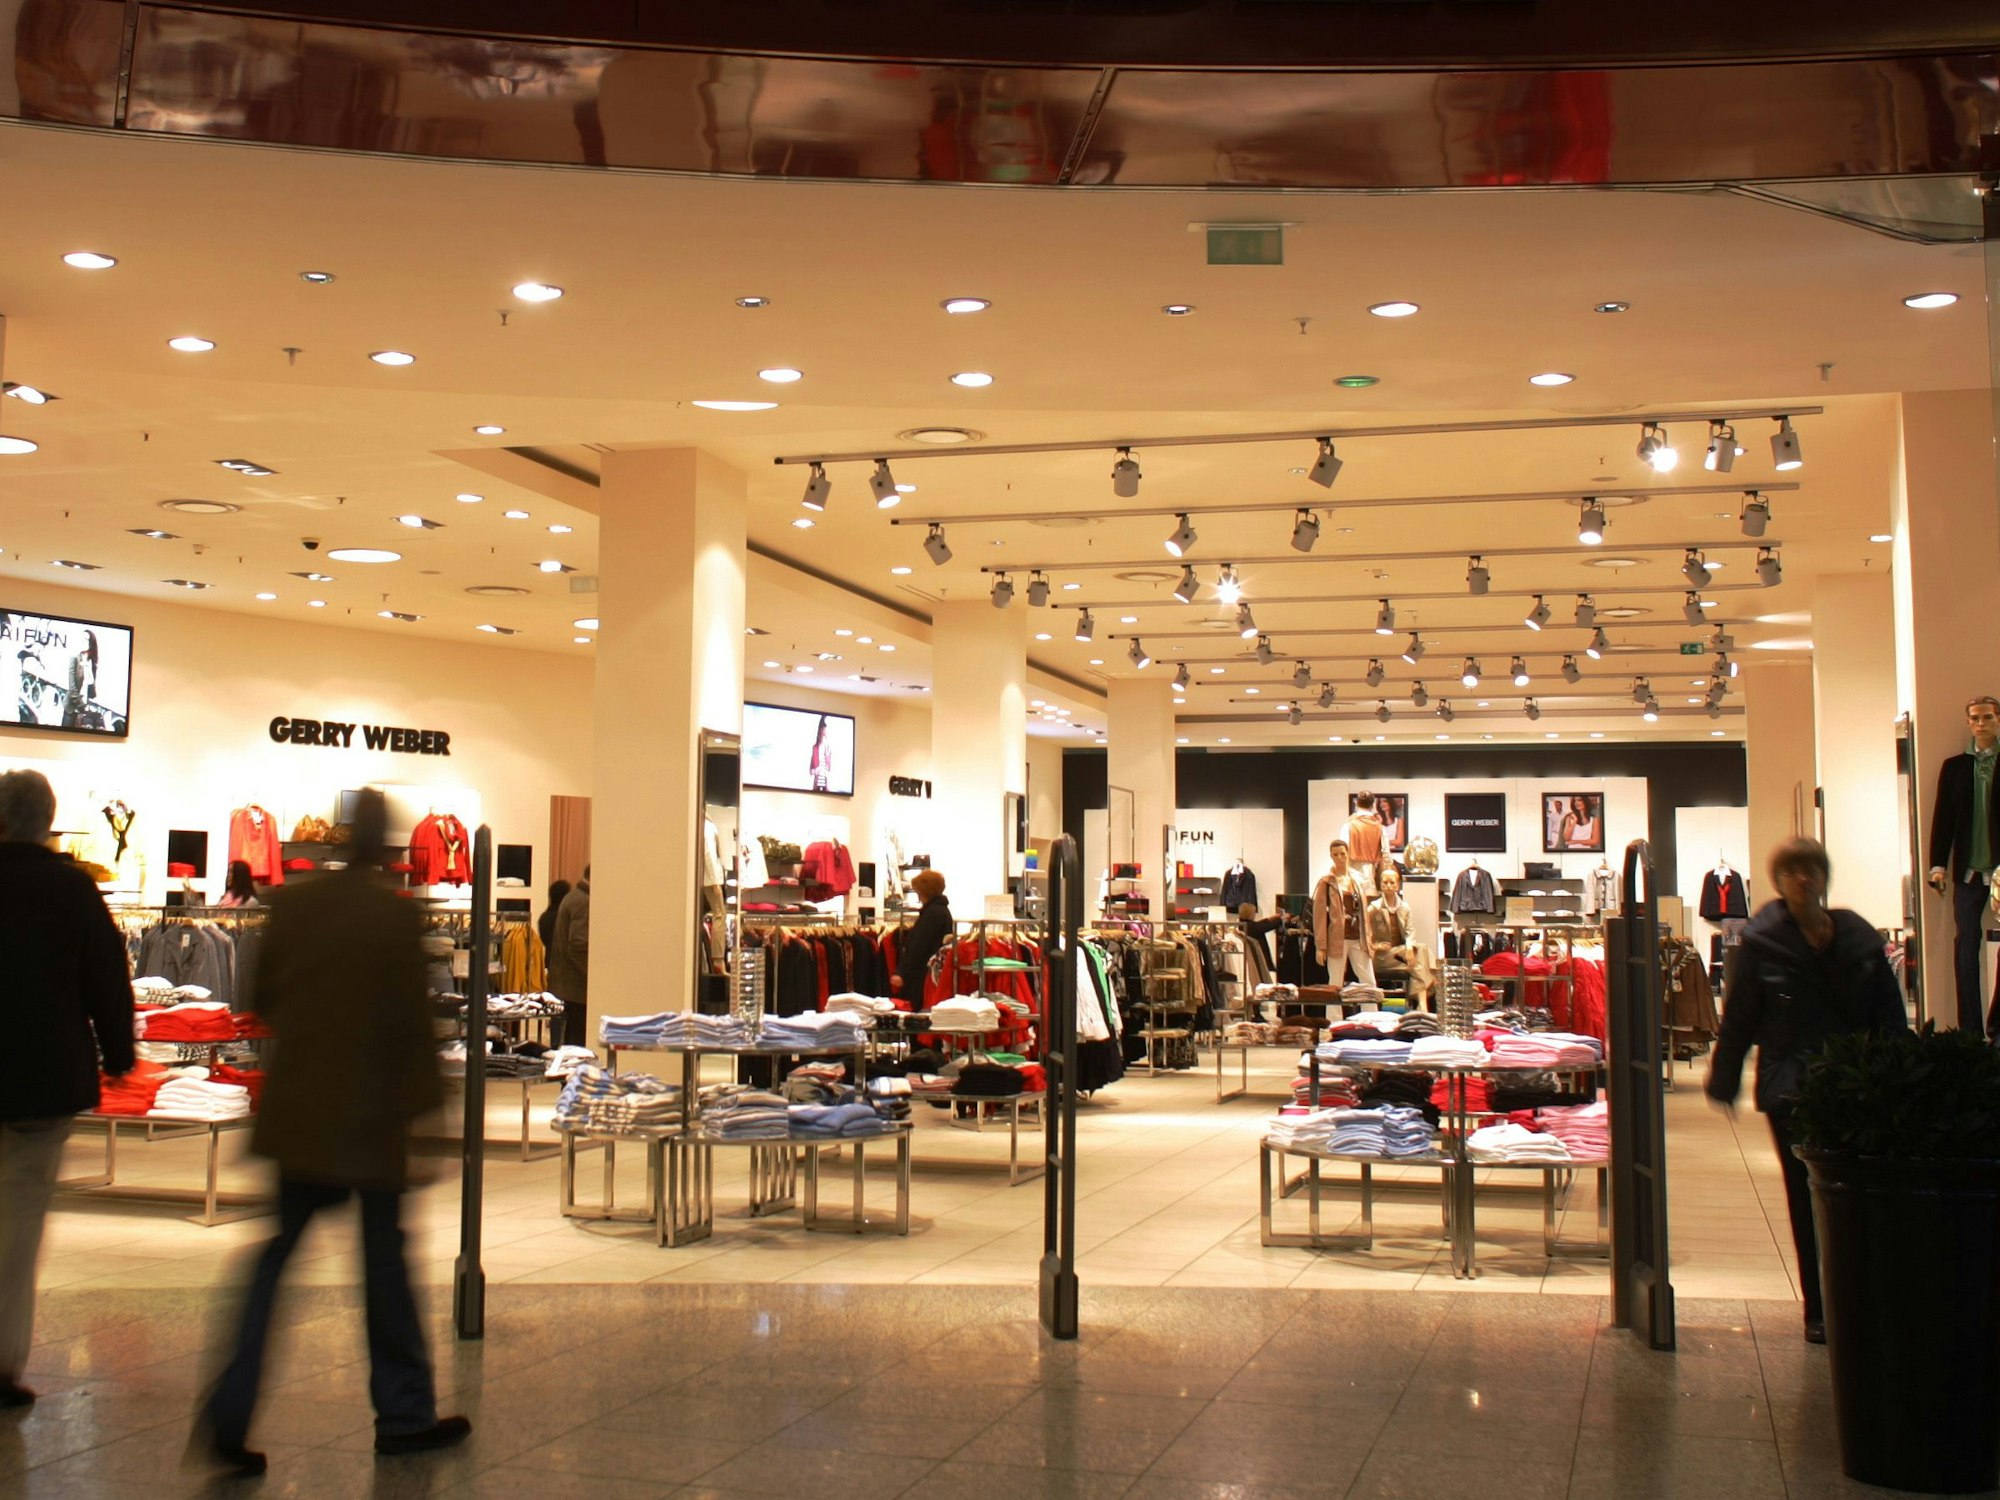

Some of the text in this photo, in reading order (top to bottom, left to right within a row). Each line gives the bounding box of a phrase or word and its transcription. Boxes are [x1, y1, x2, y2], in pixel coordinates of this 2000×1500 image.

[269, 716, 451, 756] GERRY WEBER
[889, 774, 923, 798] GERRY
